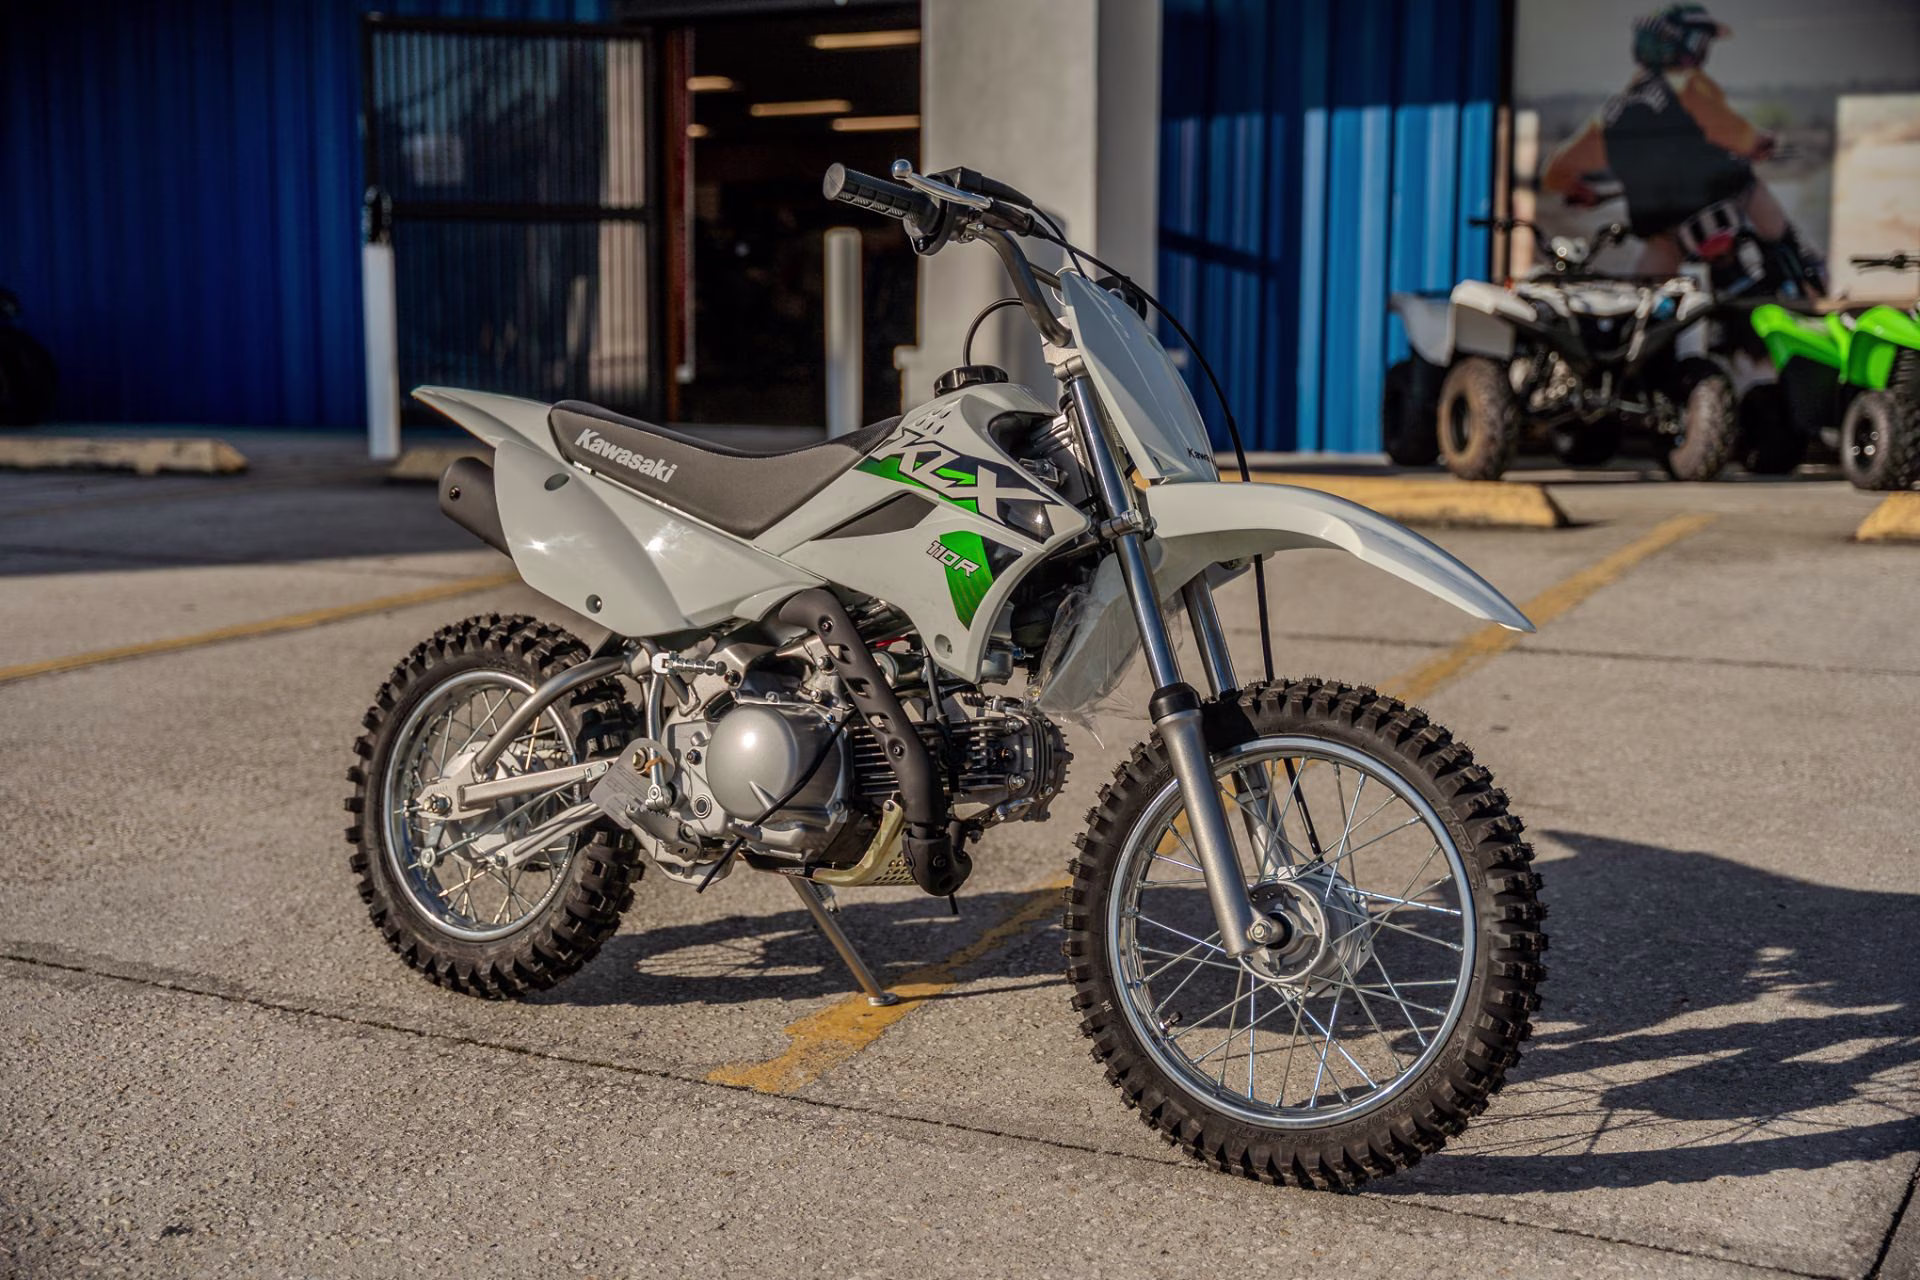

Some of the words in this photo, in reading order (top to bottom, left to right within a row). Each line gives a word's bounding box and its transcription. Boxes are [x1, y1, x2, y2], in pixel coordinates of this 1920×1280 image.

[574, 428, 678, 483] Kawasaki
[868, 427, 1053, 526] KLX
[926, 540, 981, 577] 110R
